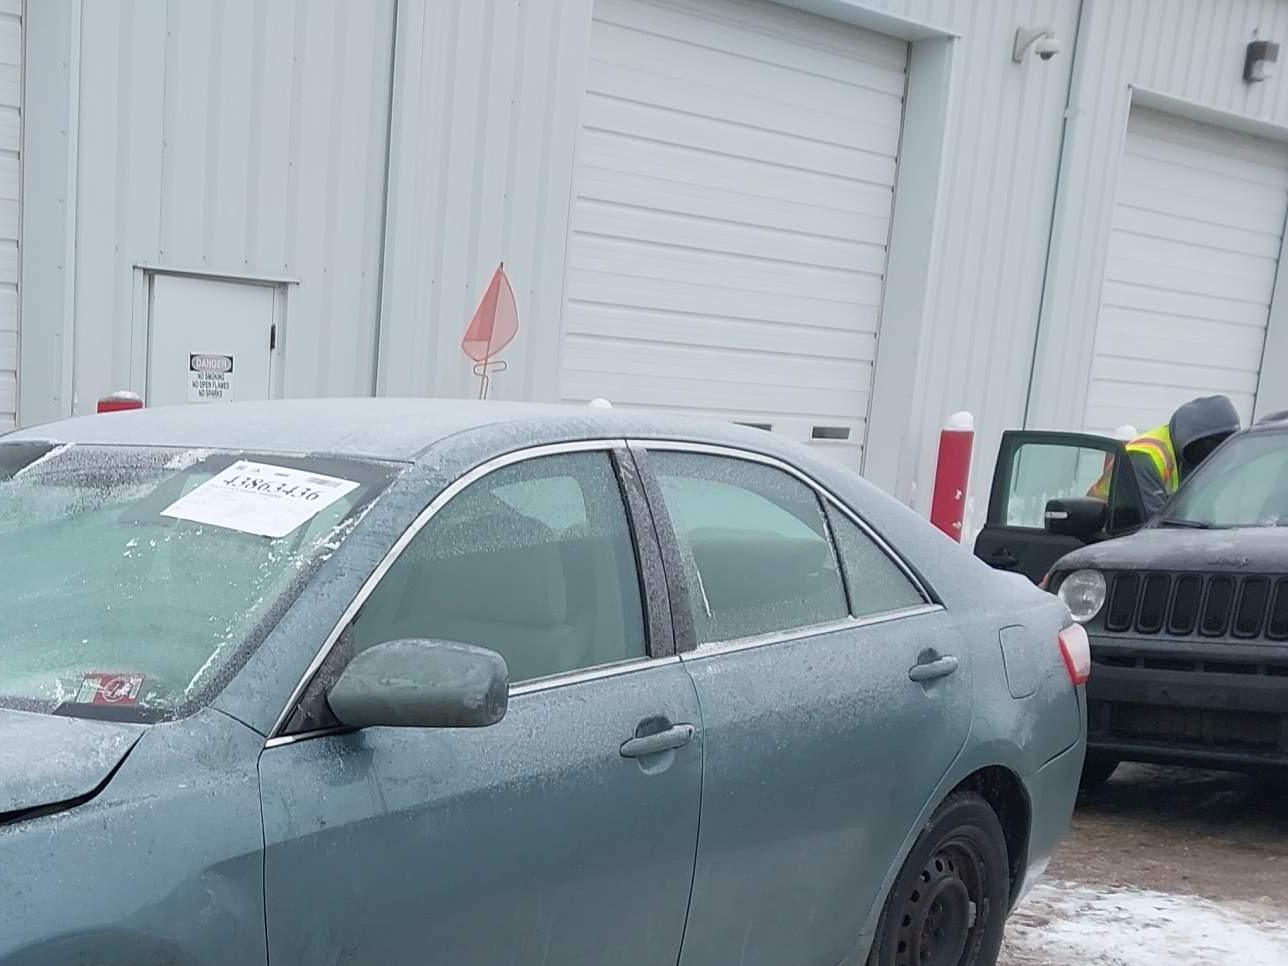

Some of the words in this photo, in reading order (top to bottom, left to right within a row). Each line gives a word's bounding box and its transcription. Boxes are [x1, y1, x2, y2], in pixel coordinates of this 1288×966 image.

[196, 358, 228, 369] DANGER
[199, 380, 212, 389] OPEN
[212, 380, 230, 390] FLAMES
[205, 389, 223, 398] SPARKS
[222, 474, 320, 502] 43863436
